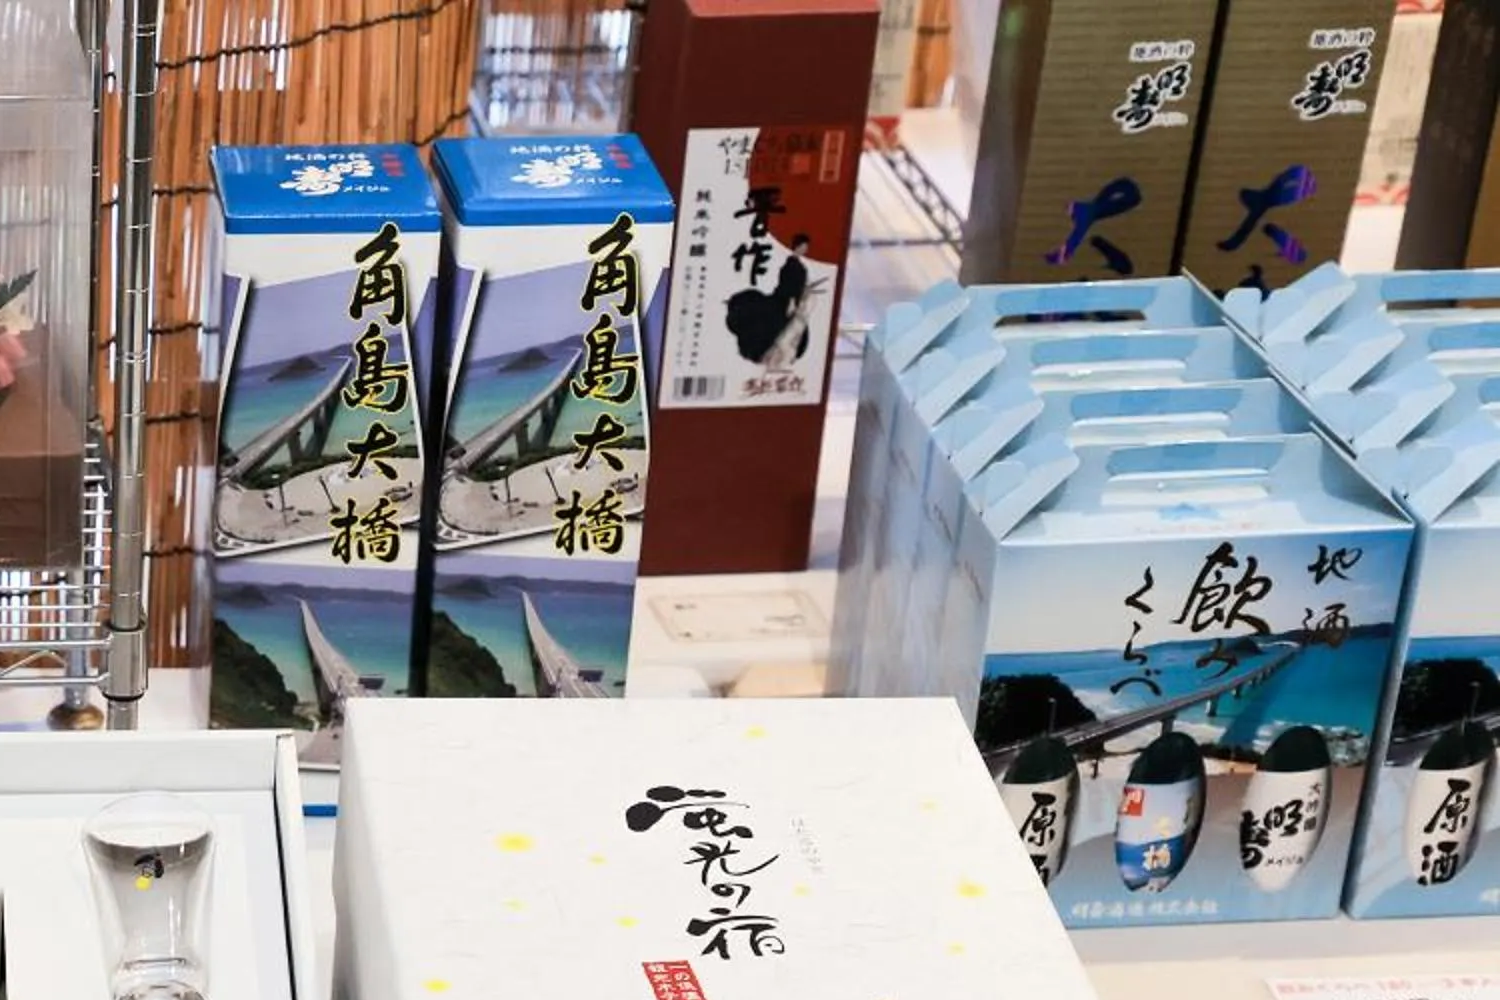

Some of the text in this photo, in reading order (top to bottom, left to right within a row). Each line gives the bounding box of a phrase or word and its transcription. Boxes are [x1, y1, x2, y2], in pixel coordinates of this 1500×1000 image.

[330, 221, 410, 565] 角島大橋
[554, 211, 640, 558] 角島大橋
[1417, 778, 1473, 887] 原酒
